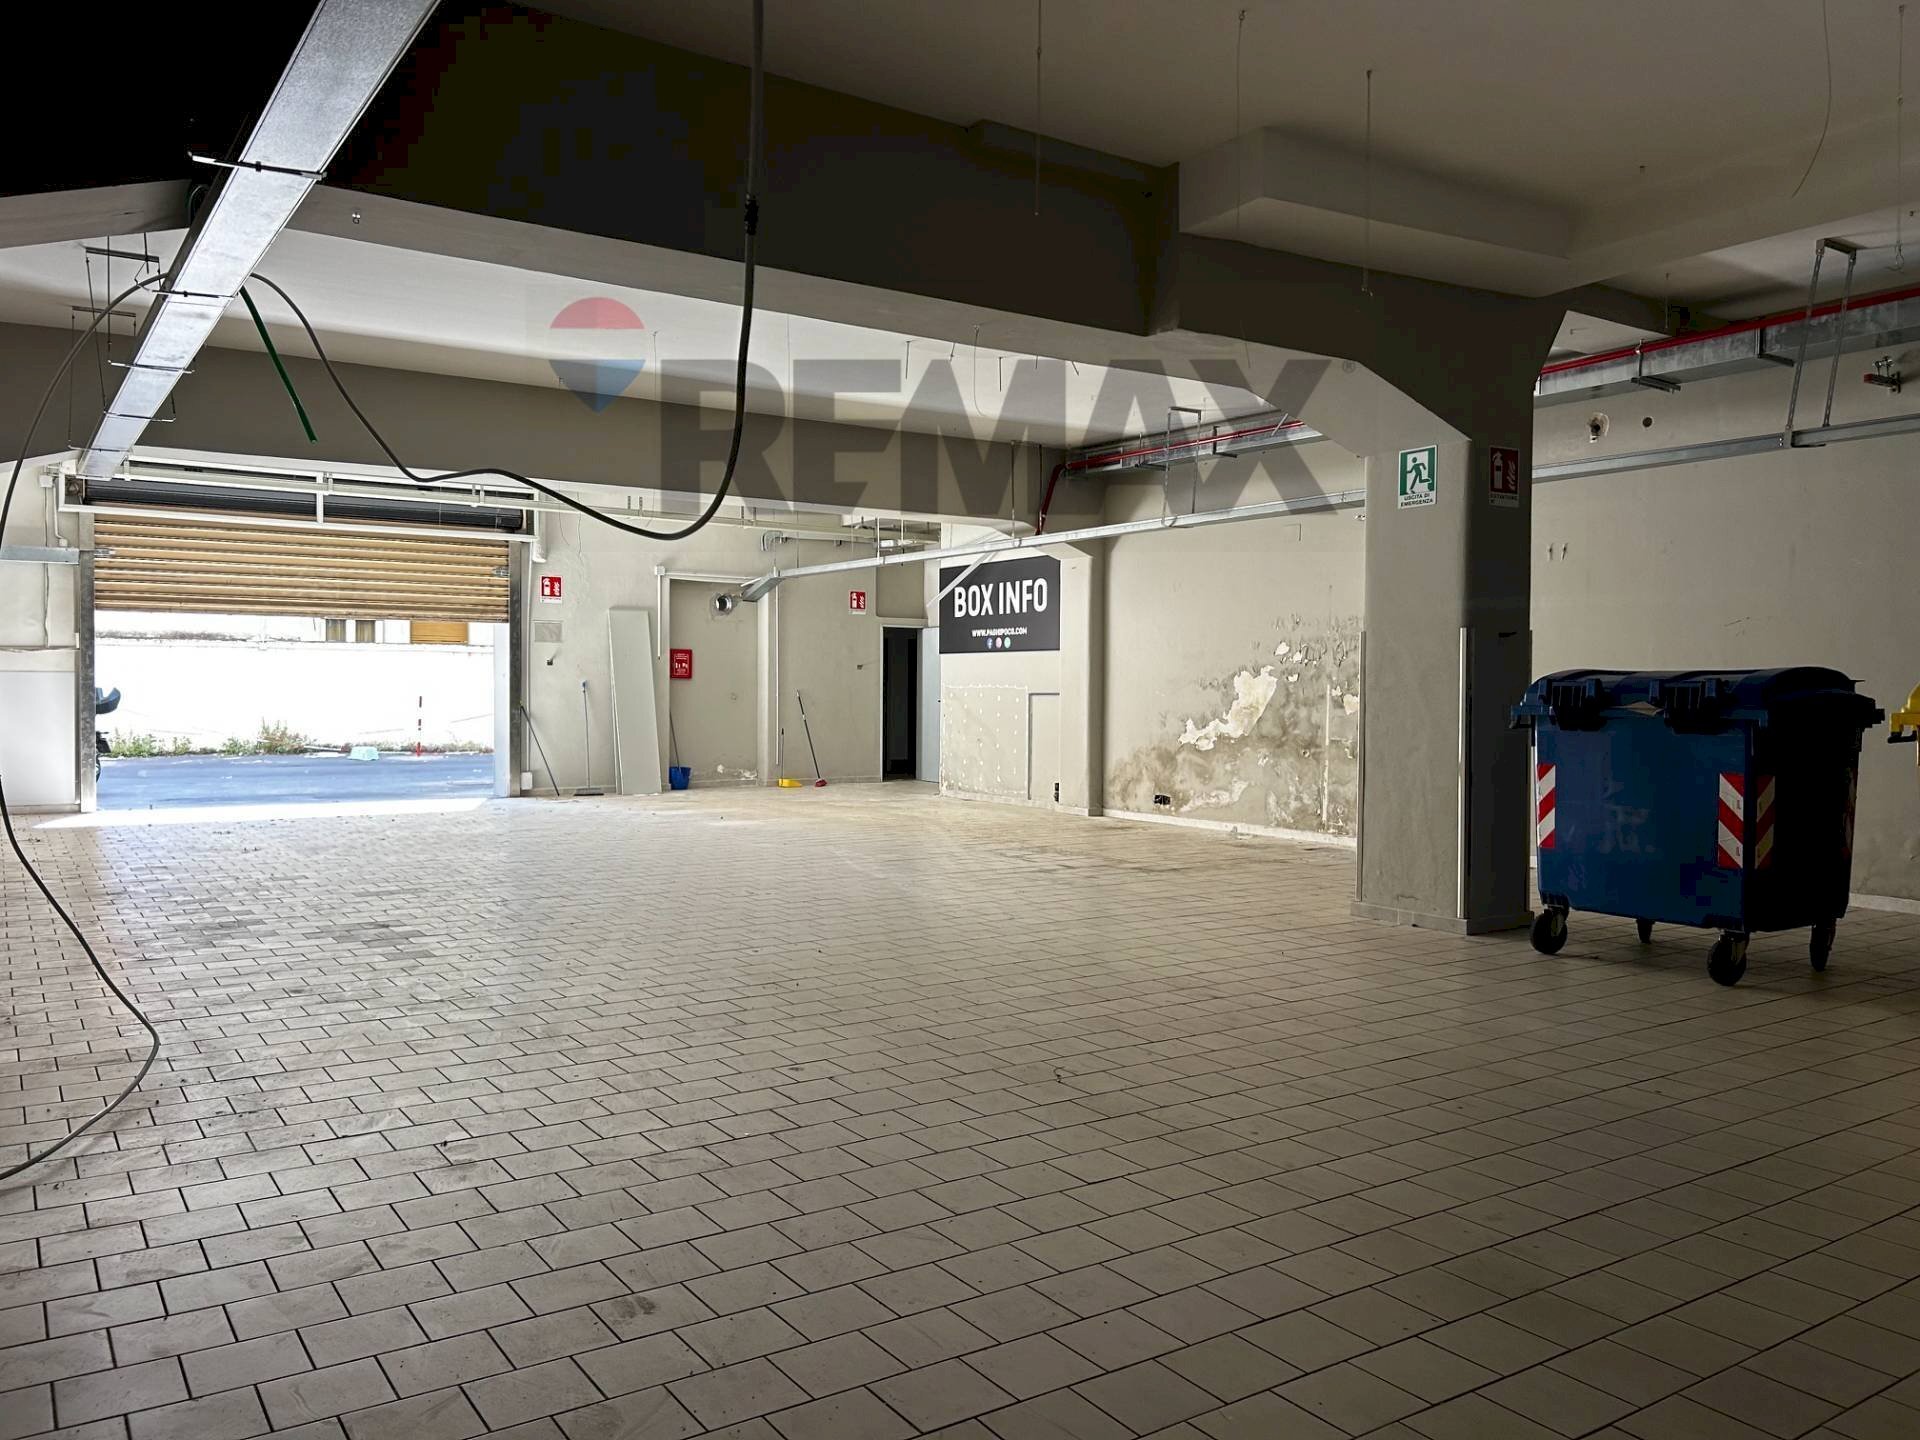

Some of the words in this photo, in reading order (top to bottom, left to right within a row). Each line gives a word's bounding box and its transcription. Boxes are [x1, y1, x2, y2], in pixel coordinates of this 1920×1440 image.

[1400, 498, 1433, 507] EMERGENZA
[954, 584, 994, 618] BOX
[998, 578, 1048, 615] INFO
